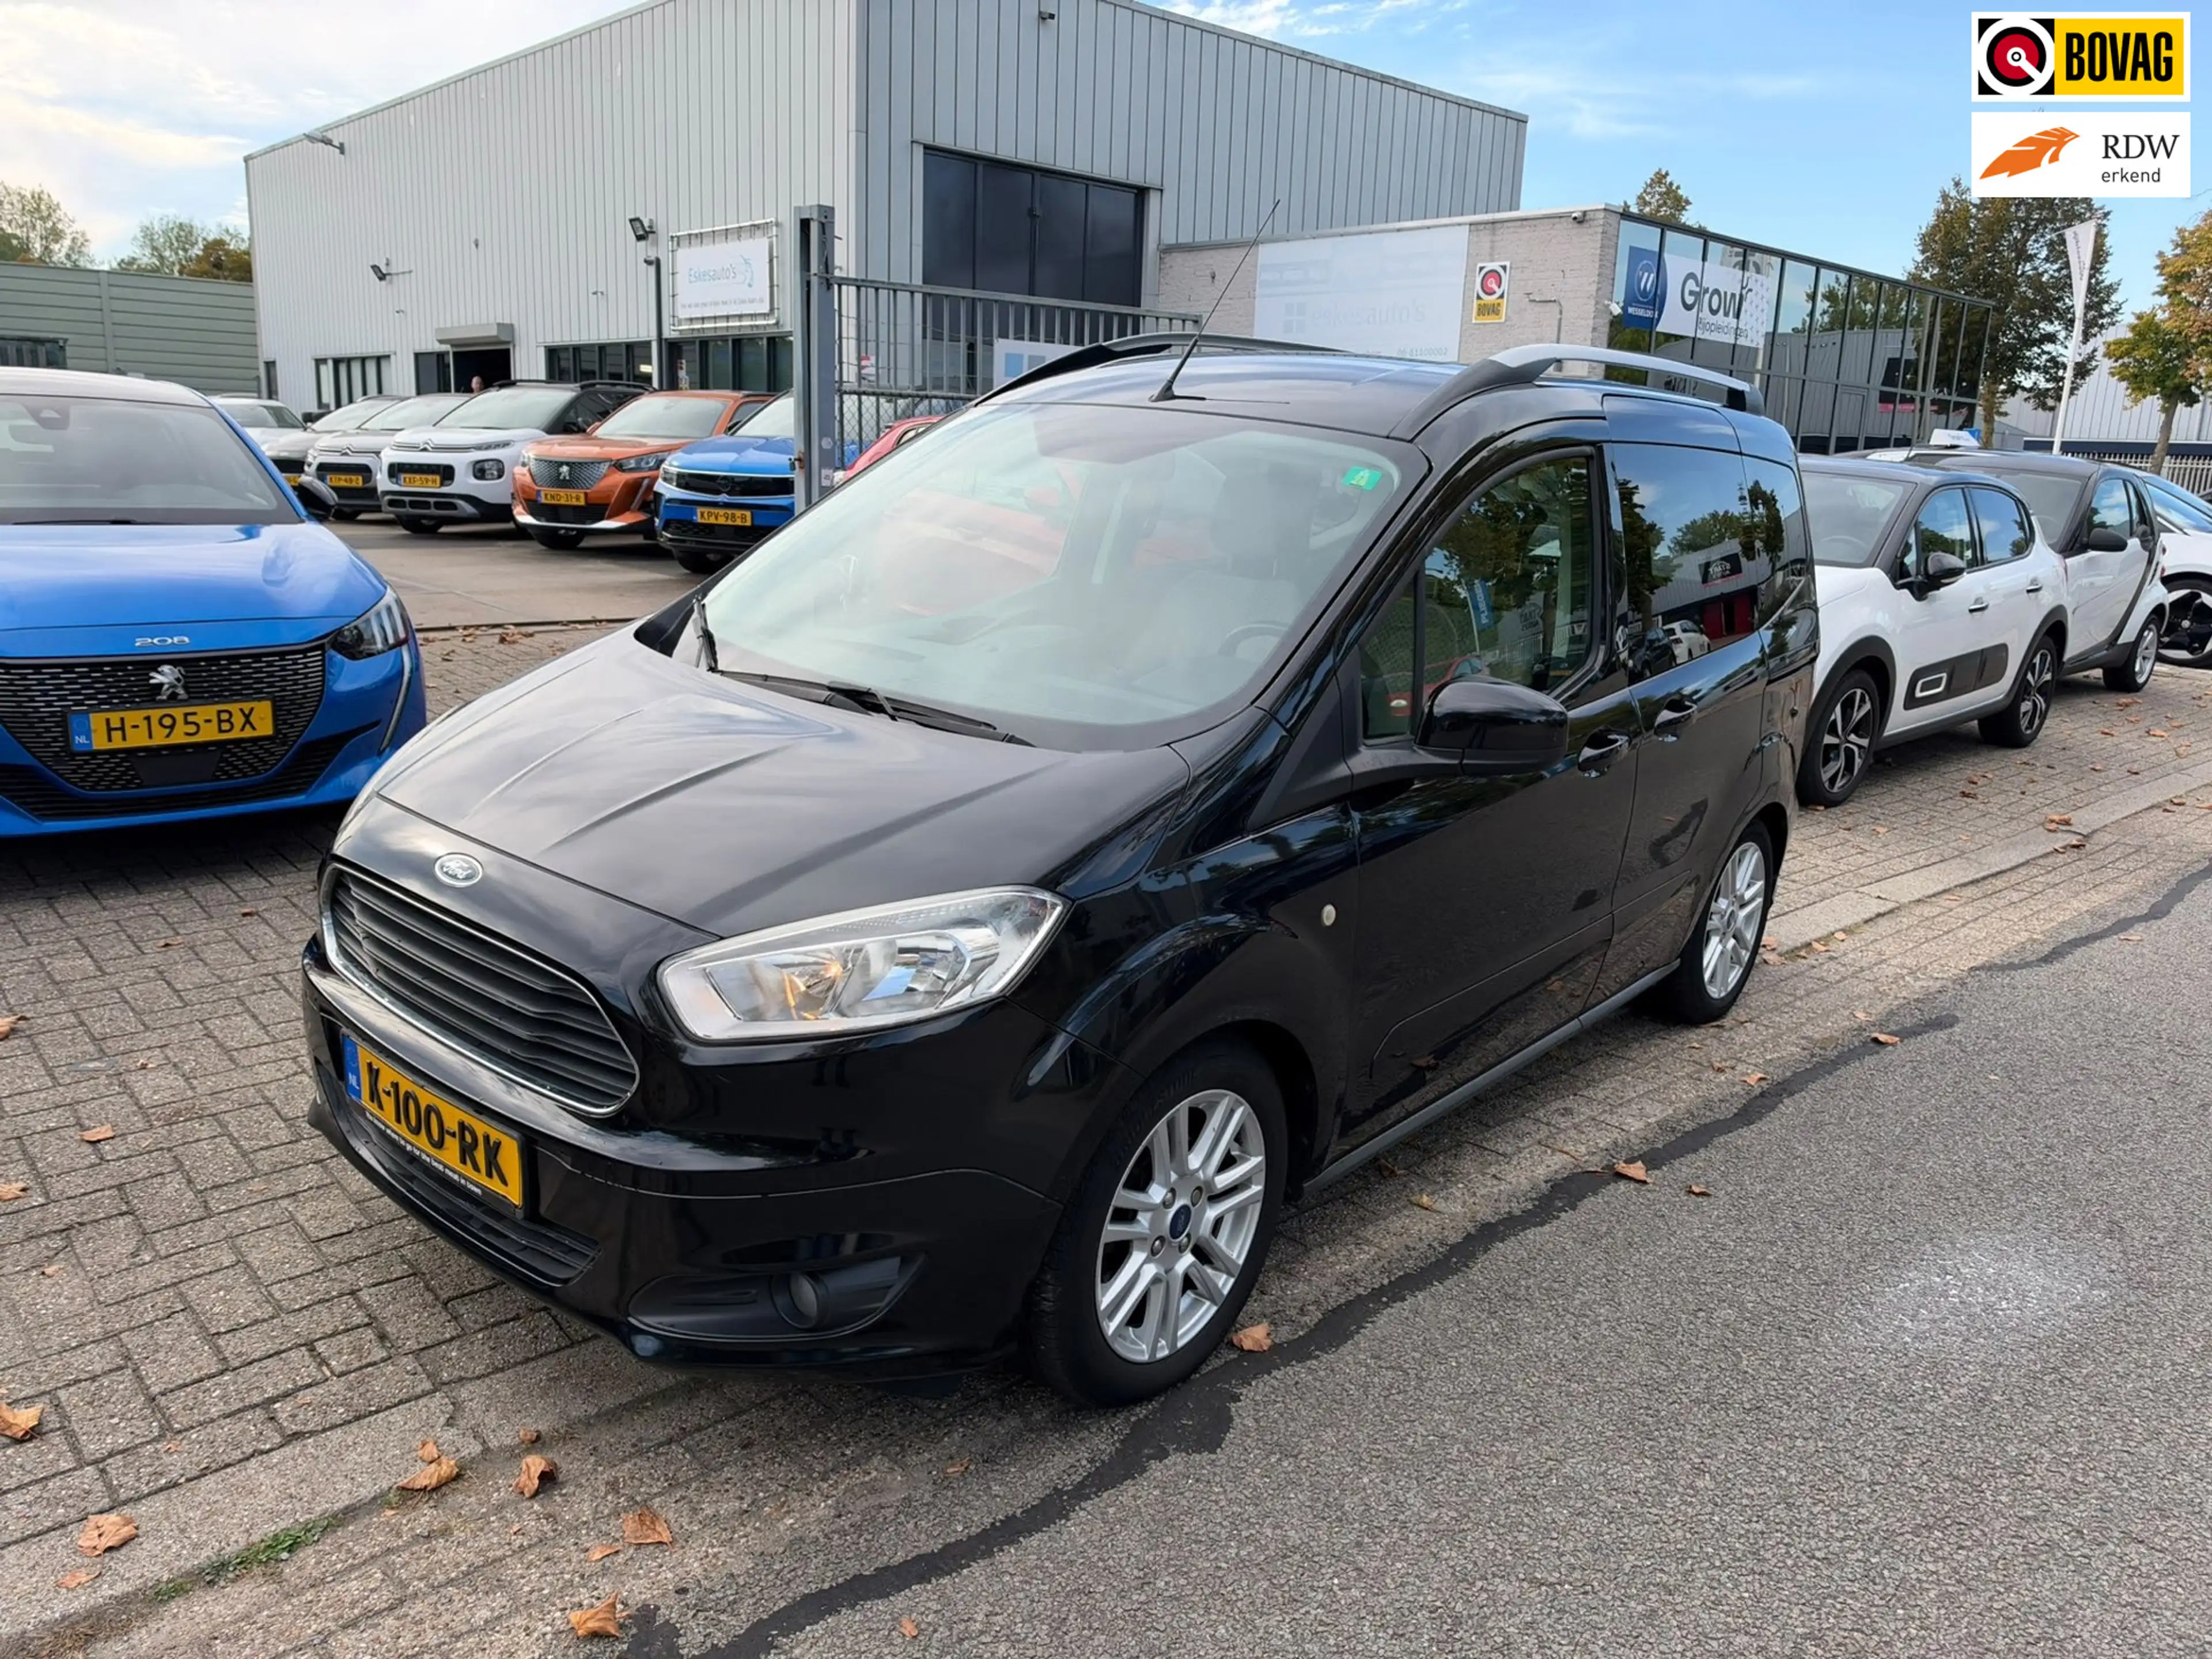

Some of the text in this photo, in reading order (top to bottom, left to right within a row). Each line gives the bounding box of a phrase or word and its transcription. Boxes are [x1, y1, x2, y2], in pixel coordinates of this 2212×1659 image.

[1477, 302, 1501, 316] BOVAG
[544, 491, 582, 503] KND-31-R
[699, 509, 748, 524] KPV-98-B
[134, 636, 190, 647] 208
[75, 706, 257, 744] NL H-195-BX
[442, 859, 473, 880] Ford
[348, 1059, 509, 1187] NL K-100-RK
